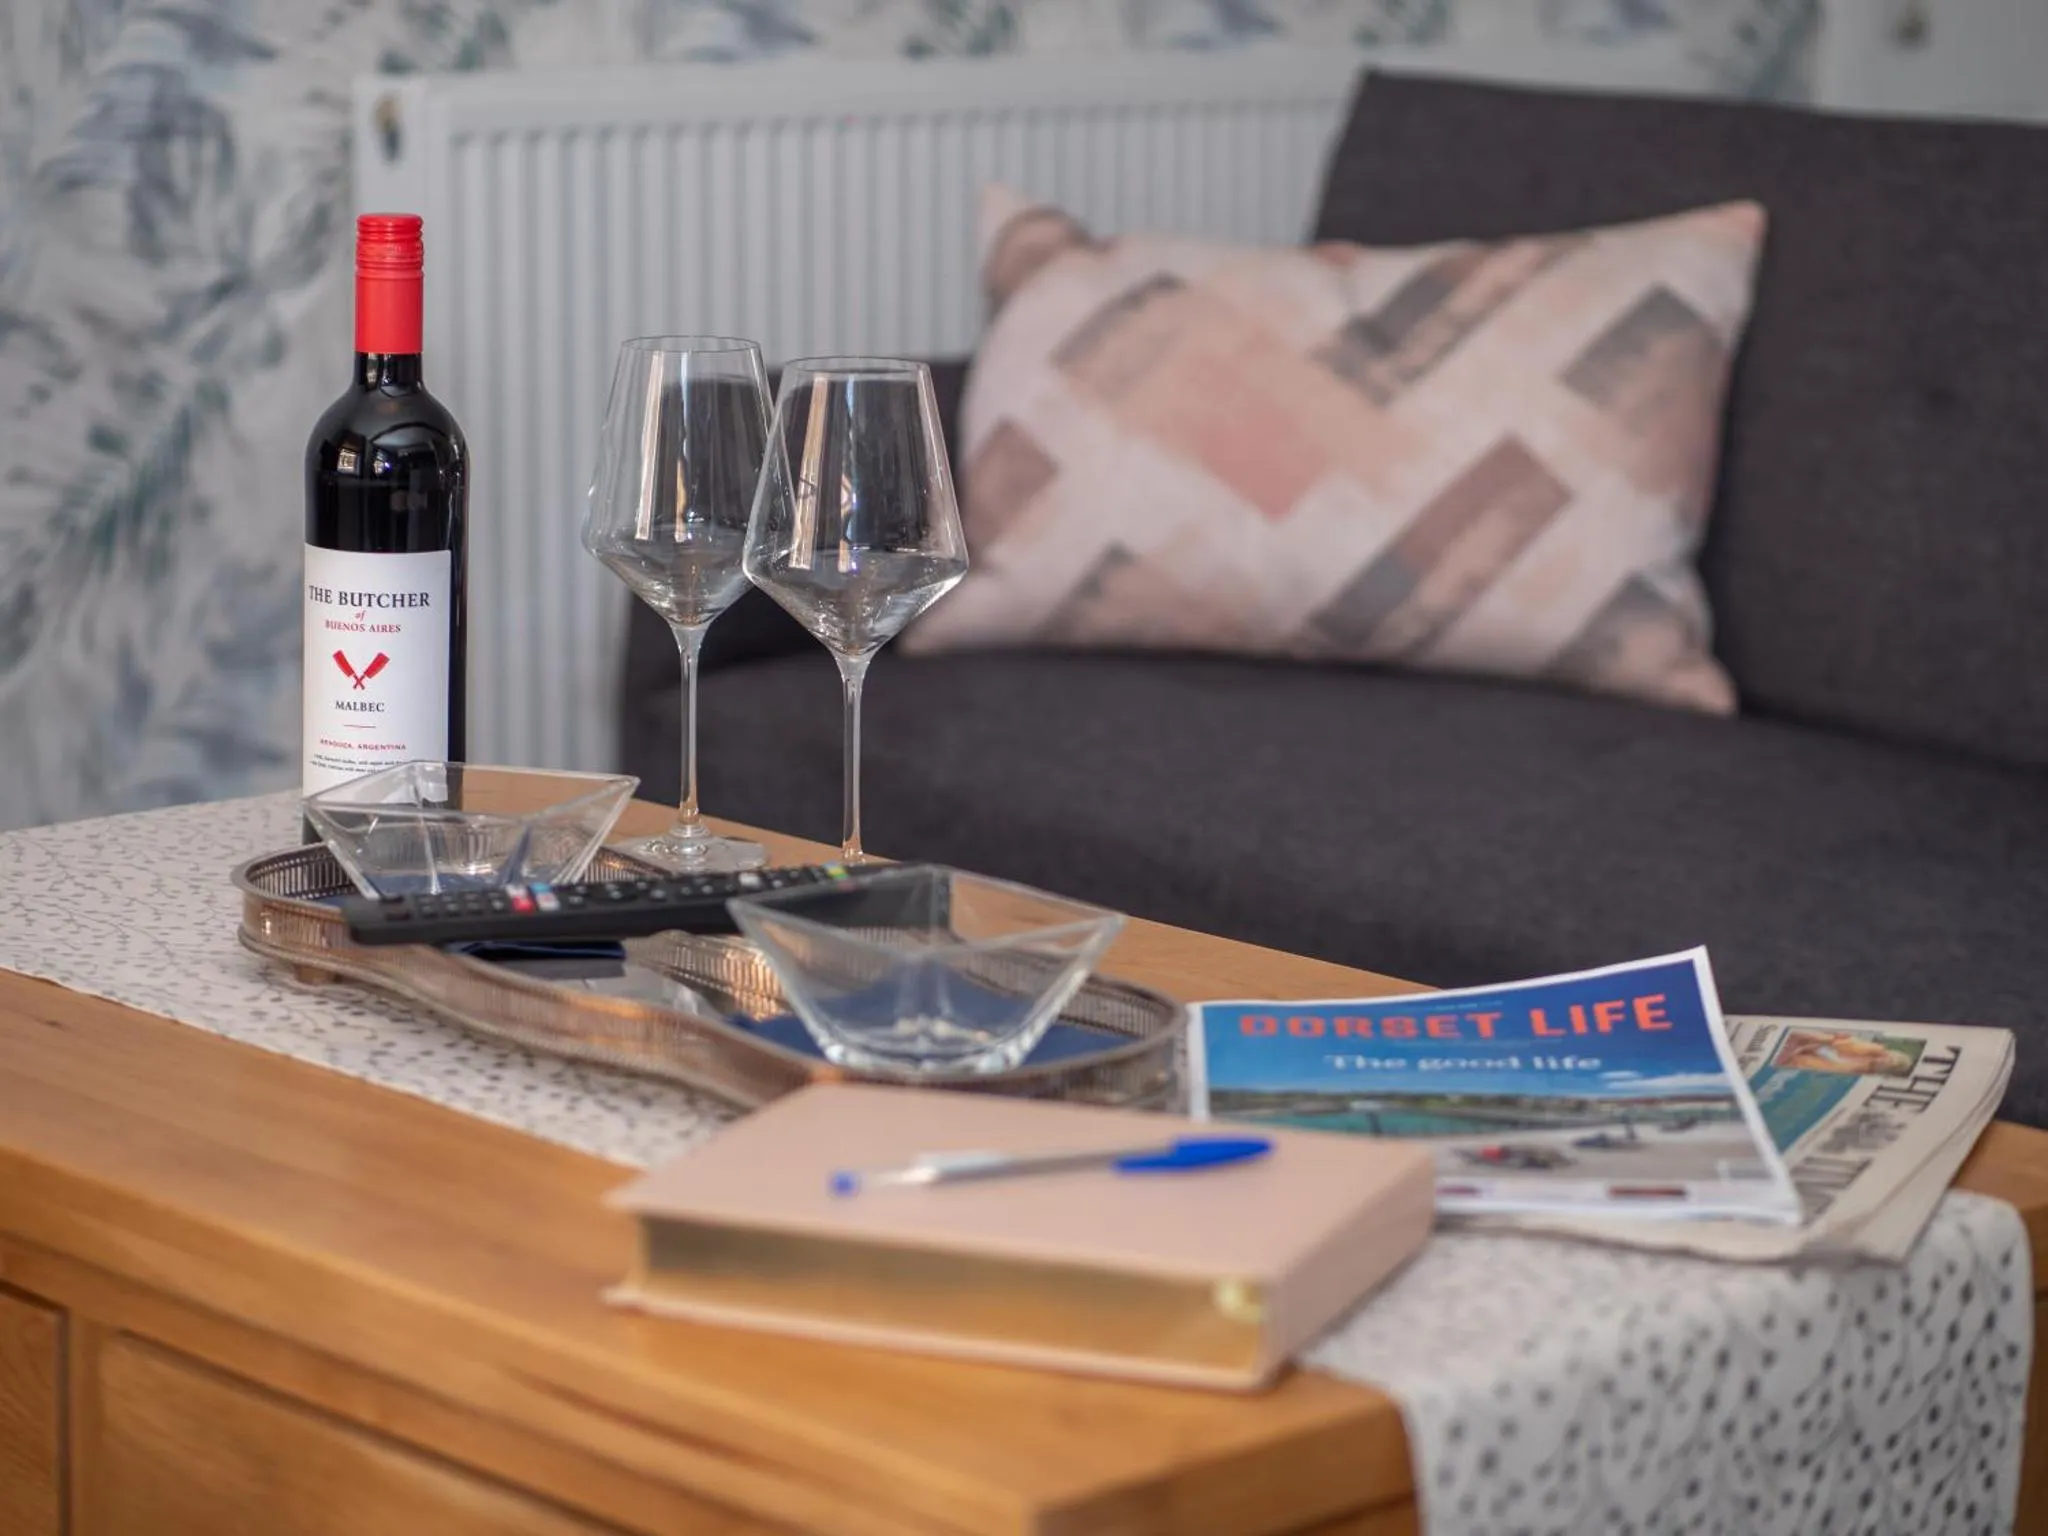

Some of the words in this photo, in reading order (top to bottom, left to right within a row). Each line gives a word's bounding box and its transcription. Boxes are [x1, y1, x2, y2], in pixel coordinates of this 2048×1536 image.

[308, 585, 333, 604] THE
[338, 591, 431, 609] BUTCHER
[355, 610, 367, 621] of
[325, 619, 366, 633] BUENOS
[369, 623, 402, 634] AIRES
[335, 700, 385, 713] MALBEC
[357, 743, 407, 751] ARGENTINA
[1238, 1011, 1502, 1040] DORSET
[1530, 994, 1673, 1037] LIFE
[1323, 1053, 1407, 1071] The
[1416, 1055, 1521, 1072] good
[1532, 1053, 1602, 1071] life
[1861, 1045, 1963, 1114] THE
